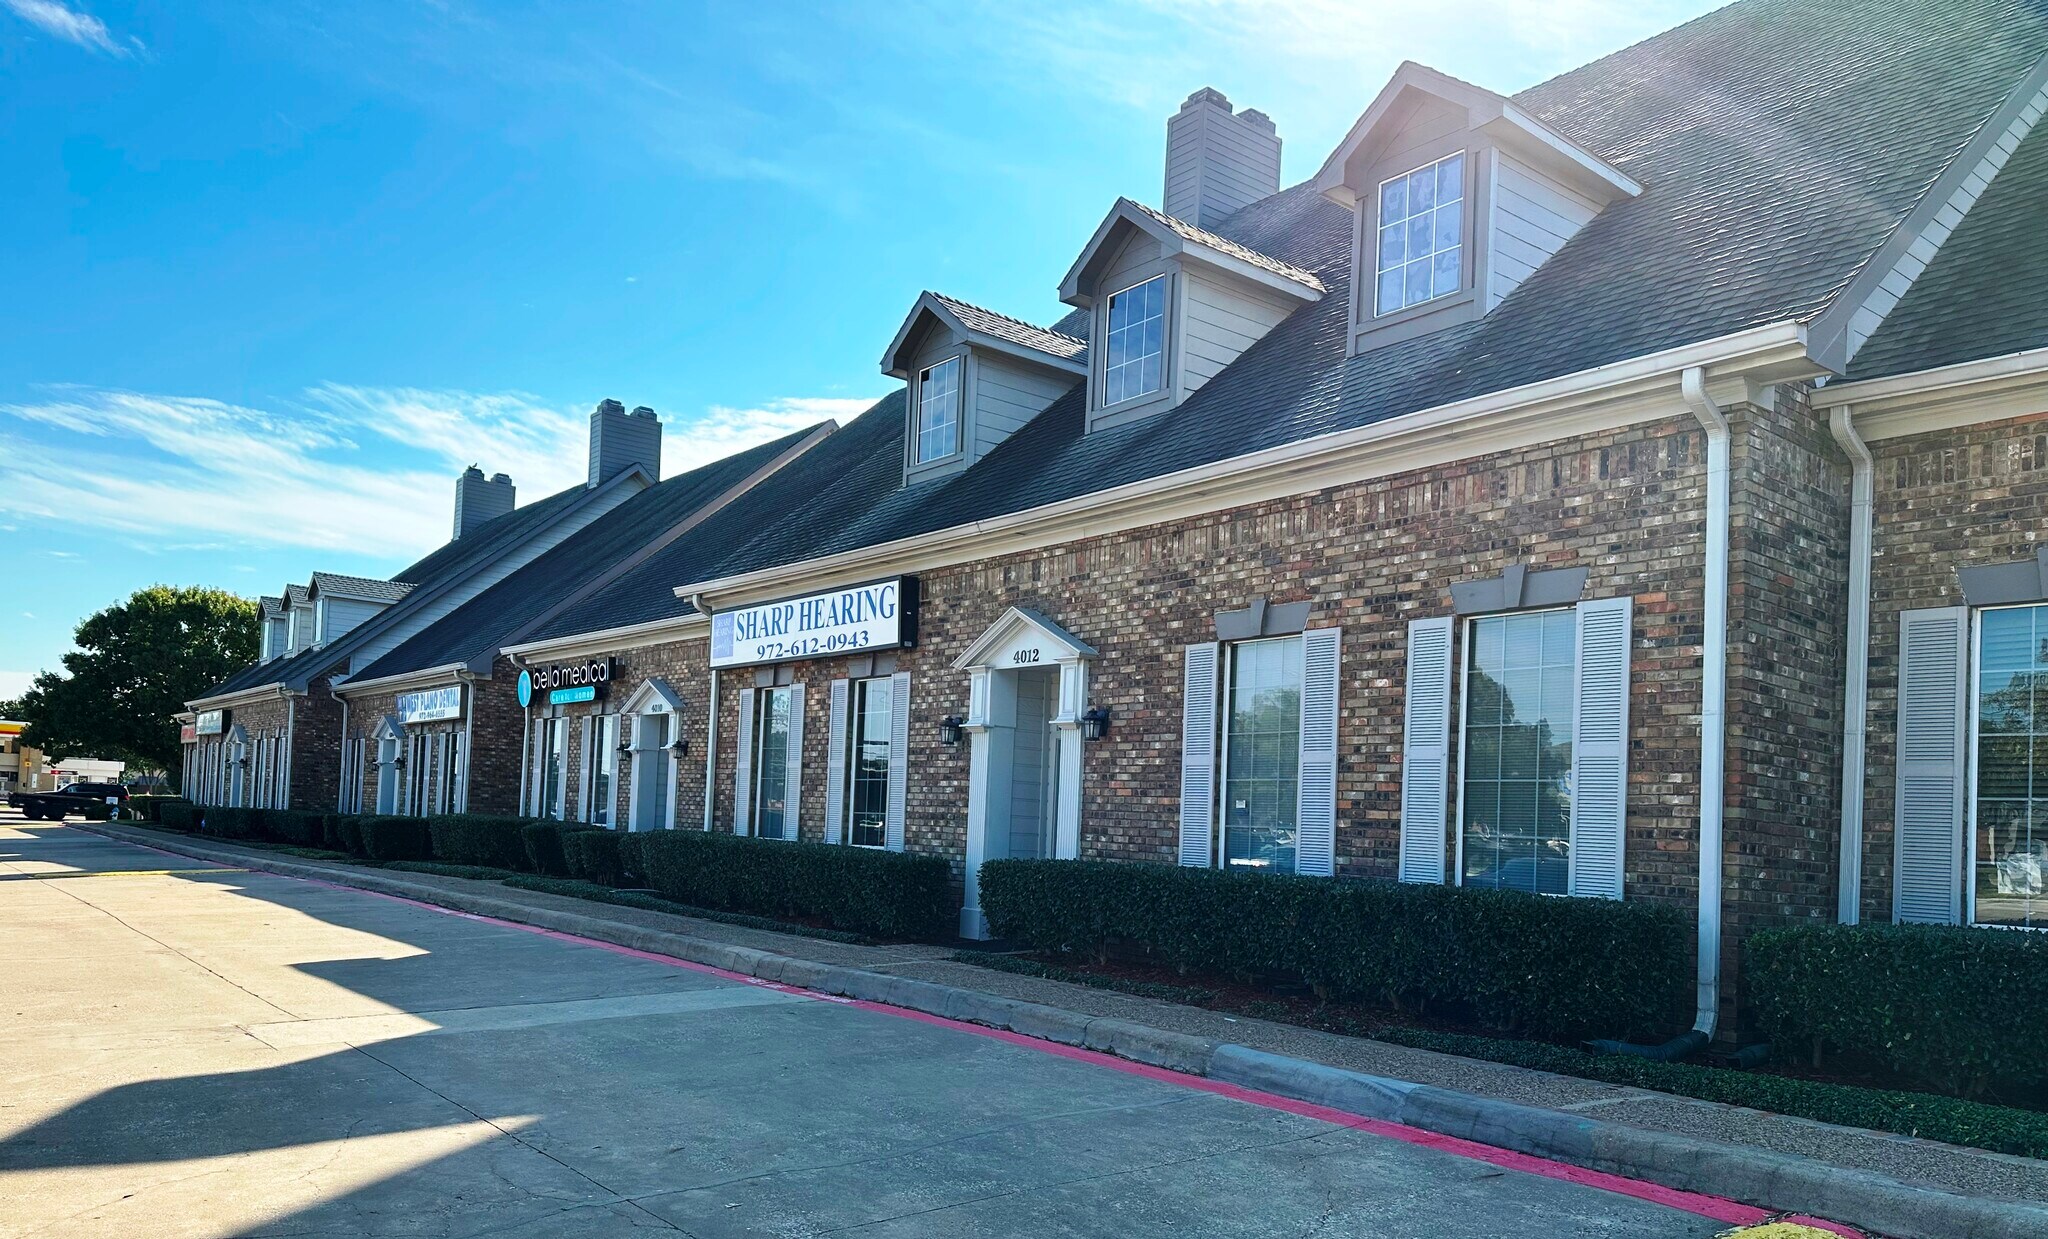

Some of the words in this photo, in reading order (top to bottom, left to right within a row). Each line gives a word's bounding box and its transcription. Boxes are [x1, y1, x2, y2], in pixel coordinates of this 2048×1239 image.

[736, 604, 794, 642] SHARP
[798, 585, 896, 632] HEARING
[757, 630, 869, 660] 972-612-0943
[1013, 648, 1040, 664] 4012
[533, 666, 559, 690] bella
[562, 657, 608, 685] medical
[420, 691, 438, 711] PLANO
